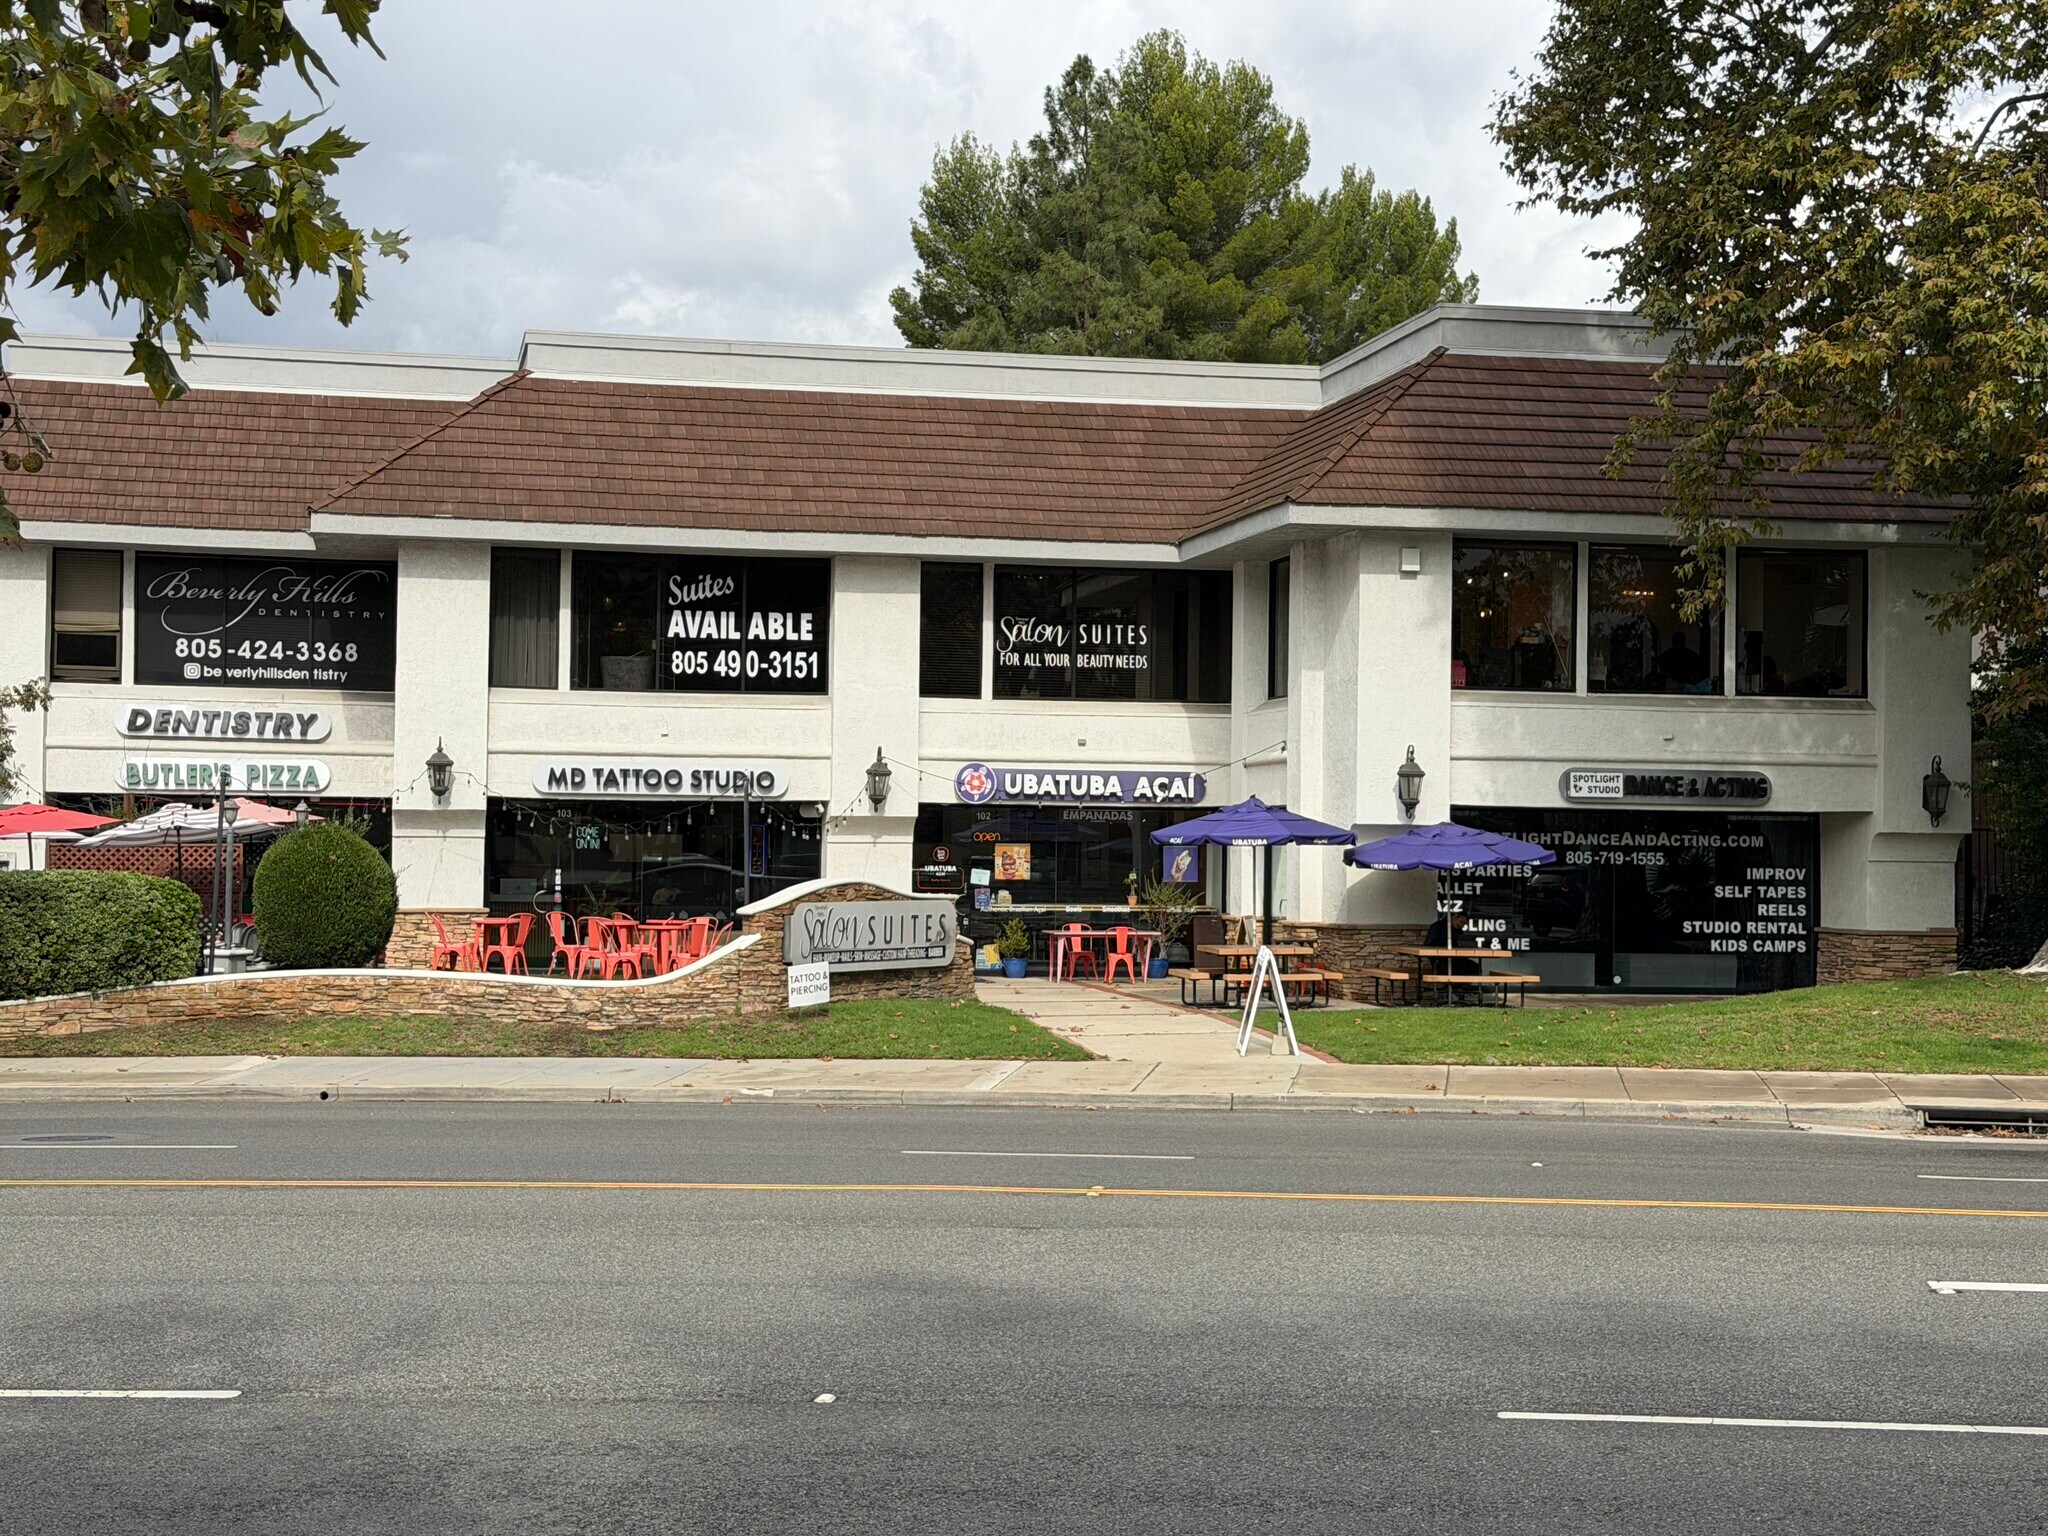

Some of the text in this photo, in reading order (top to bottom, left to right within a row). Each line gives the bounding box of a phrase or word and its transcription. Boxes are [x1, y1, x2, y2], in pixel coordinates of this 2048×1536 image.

[272, 569, 388, 604] Hills
[669, 574, 735, 605] Suites
[259, 608, 384, 619] DENTISTRY
[996, 616, 1148, 652] Salon SUITES
[175, 638, 358, 662] 805-424-3368
[671, 651, 708, 674] 805
[1000, 652, 1148, 668] FOR ALL YOUR BEAUTY NEEDS
[127, 708, 318, 738] DENTISTRY
[126, 763, 320, 789] BUTLER'S PIZZA
[548, 768, 775, 794] MD TATTOO STUDIO
[1573, 775, 1621, 784] SPOTLIGHT
[1004, 772, 1196, 803] UBATUBA AÇAÍ
[1587, 785, 1620, 794] STUDIO
[1624, 774, 1768, 798] DANCE & ACTING
[557, 809, 572, 818] 103
[976, 812, 991, 821] 102
[1063, 811, 1134, 821] EMPANADAS
[576, 826, 600, 838] COME
[576, 838, 588, 850] ON
[1232, 838, 1268, 846] UBATUBA
[1566, 852, 1664, 865] 805-719-1555
[924, 865, 957, 873] UBATUBA
[1467, 865, 1532, 877] PARTIES
[1747, 868, 1806, 880] IMPROV
[1714, 886, 1806, 898] SELF TAPES
[1758, 904, 1806, 916] REELS
[1462, 919, 1506, 932] LING
[1683, 921, 1807, 934] STUDIO RENTAL
[801, 907, 947, 959] Salon SUITES
[1490, 937, 1501, 950] &
[1508, 938, 1530, 950] ME
[1711, 940, 1807, 953] KIDS CAMPS
[790, 971, 828, 984] TATTOO &
[791, 982, 828, 995] PIERCING
